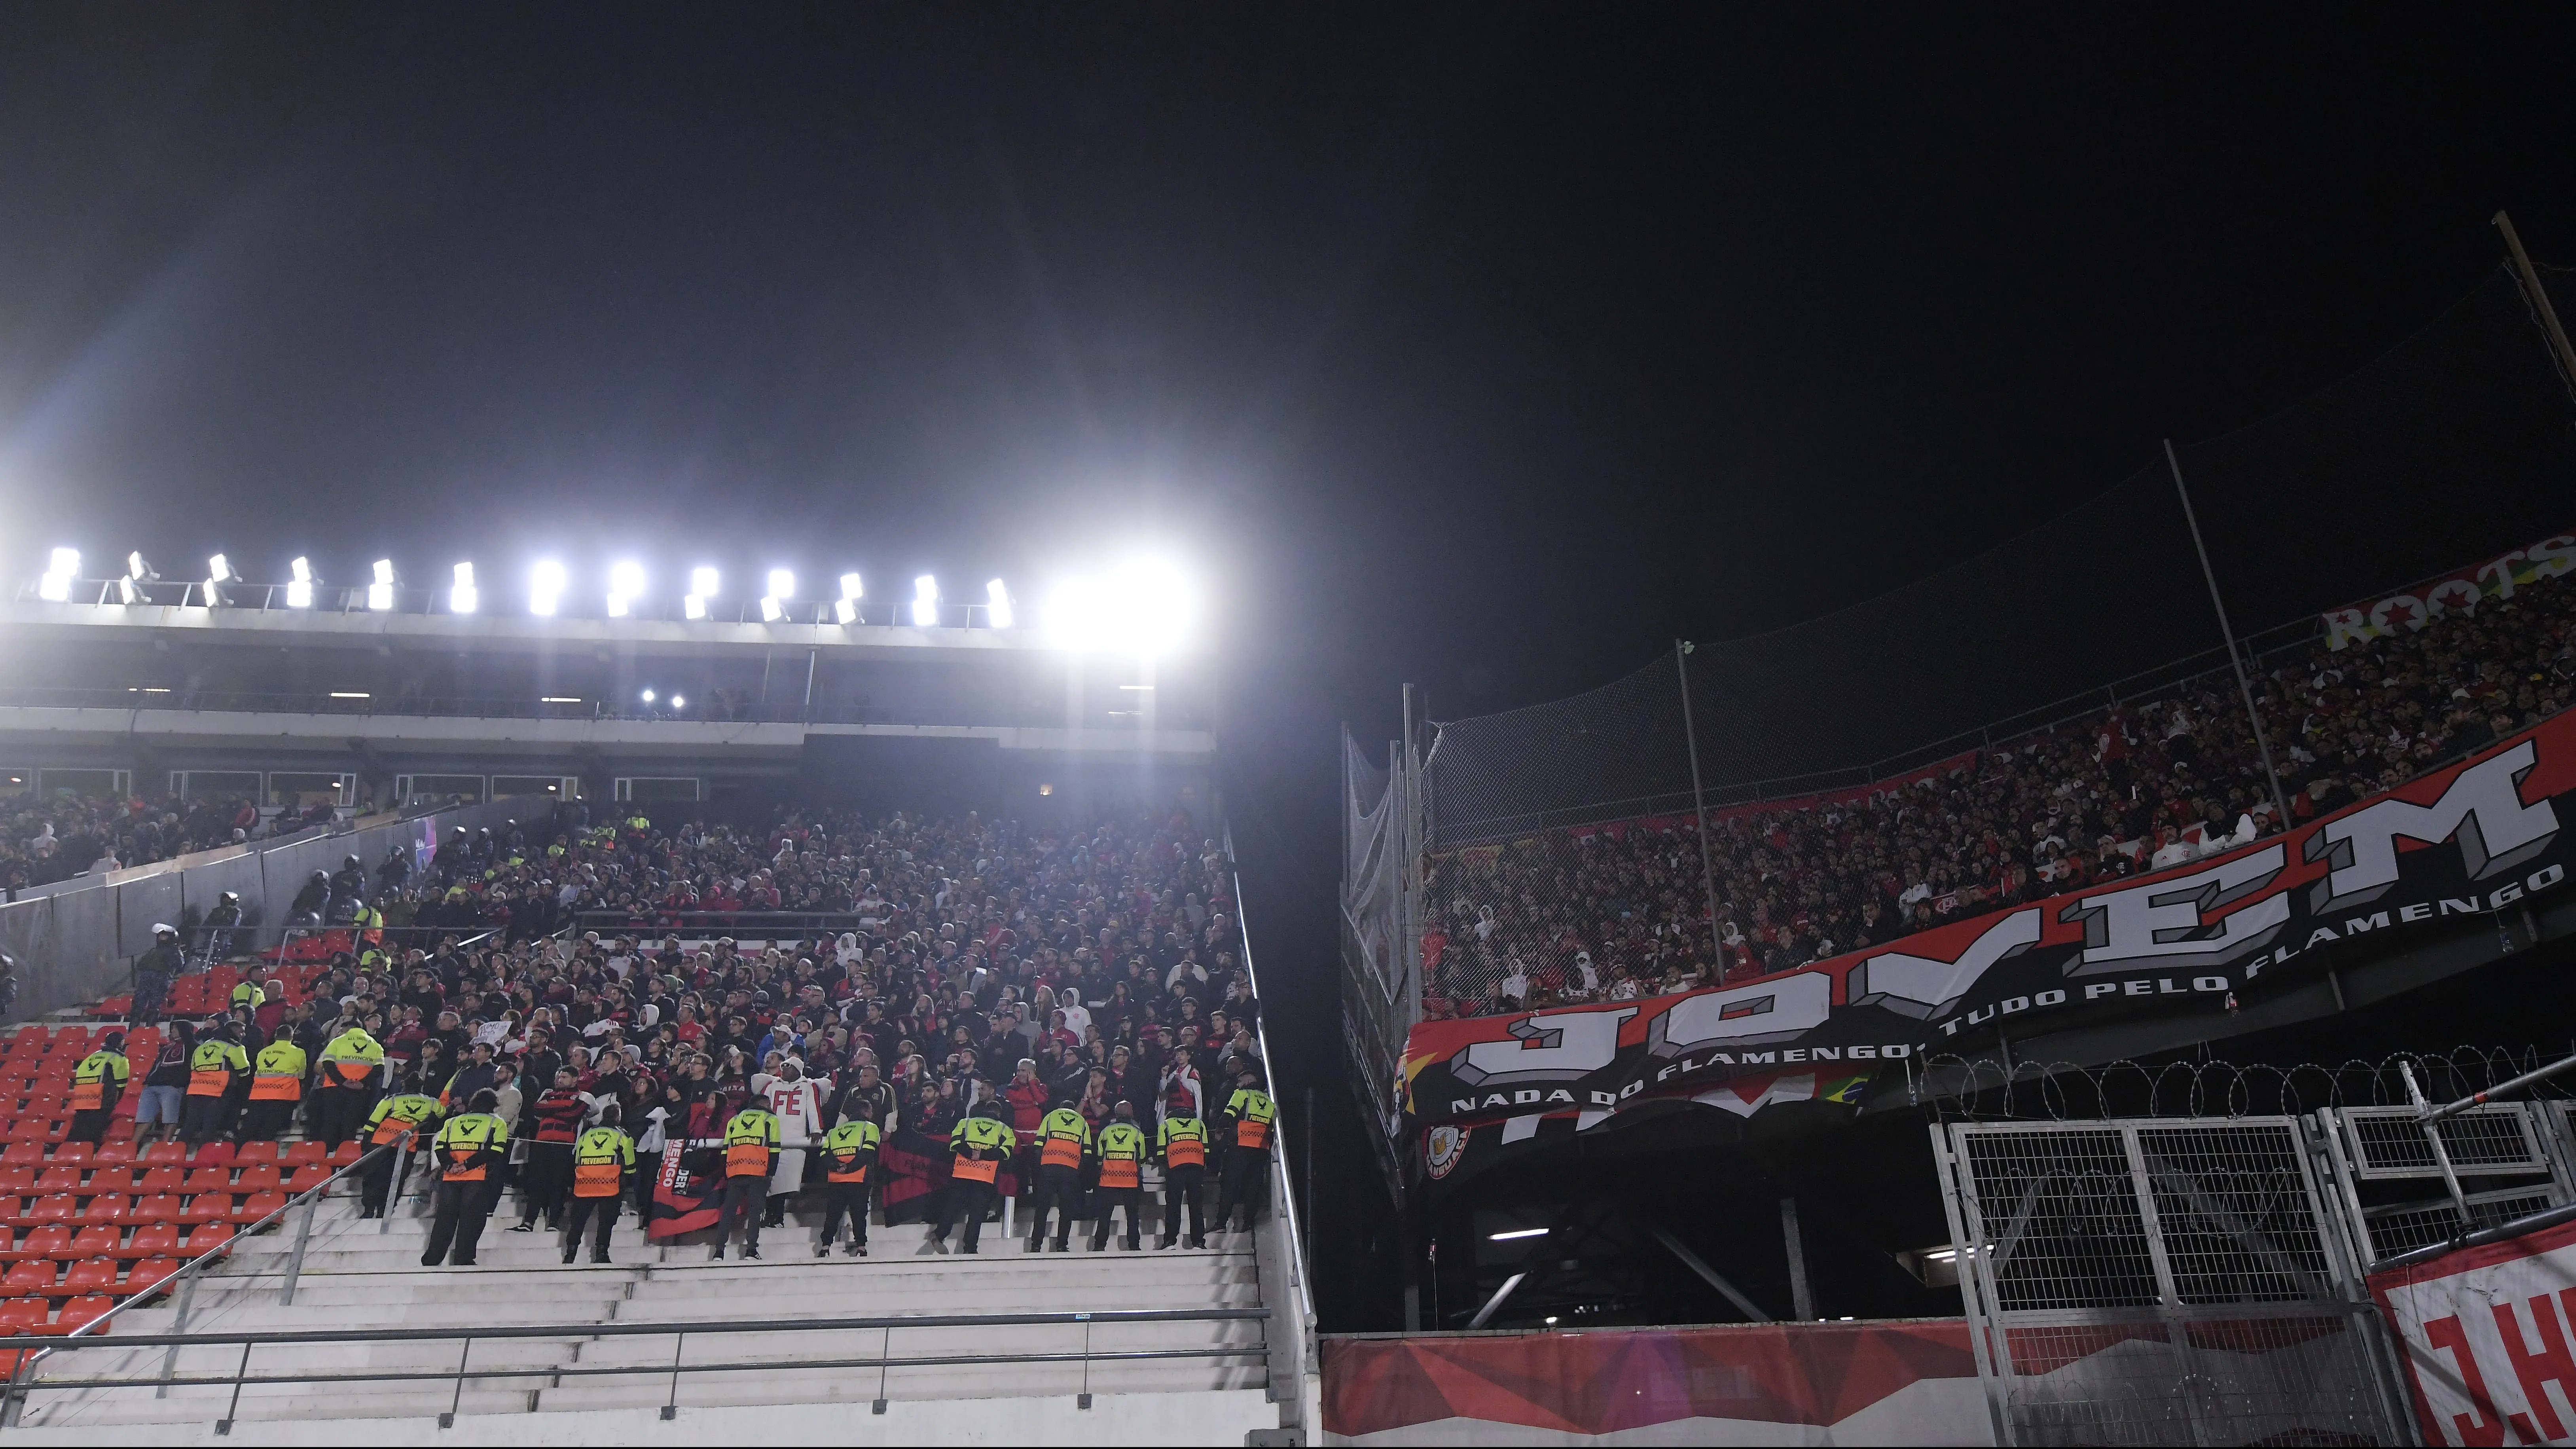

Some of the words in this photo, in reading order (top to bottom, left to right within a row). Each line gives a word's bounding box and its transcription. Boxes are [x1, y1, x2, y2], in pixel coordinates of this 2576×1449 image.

[2322, 535, 2576, 652] ROOTS
[1451, 740, 2560, 1087] JOVEM
[1452, 1089, 1575, 1113] NADA
[1591, 1080, 1643, 1105] DO
[1939, 989, 2066, 1036] TUDO
[2085, 976, 2229, 1000] PELO
[2245, 864, 2565, 979] FLAMENGO
[772, 1085, 802, 1116] FÉ
[733, 1137, 760, 1146] PREVENCIÓN
[1052, 1131, 1079, 1143] PREVENCIÓN
[1171, 1133, 1198, 1142] PREVENCIÓN
[581, 1155, 611, 1165] PREVENCIÓN
